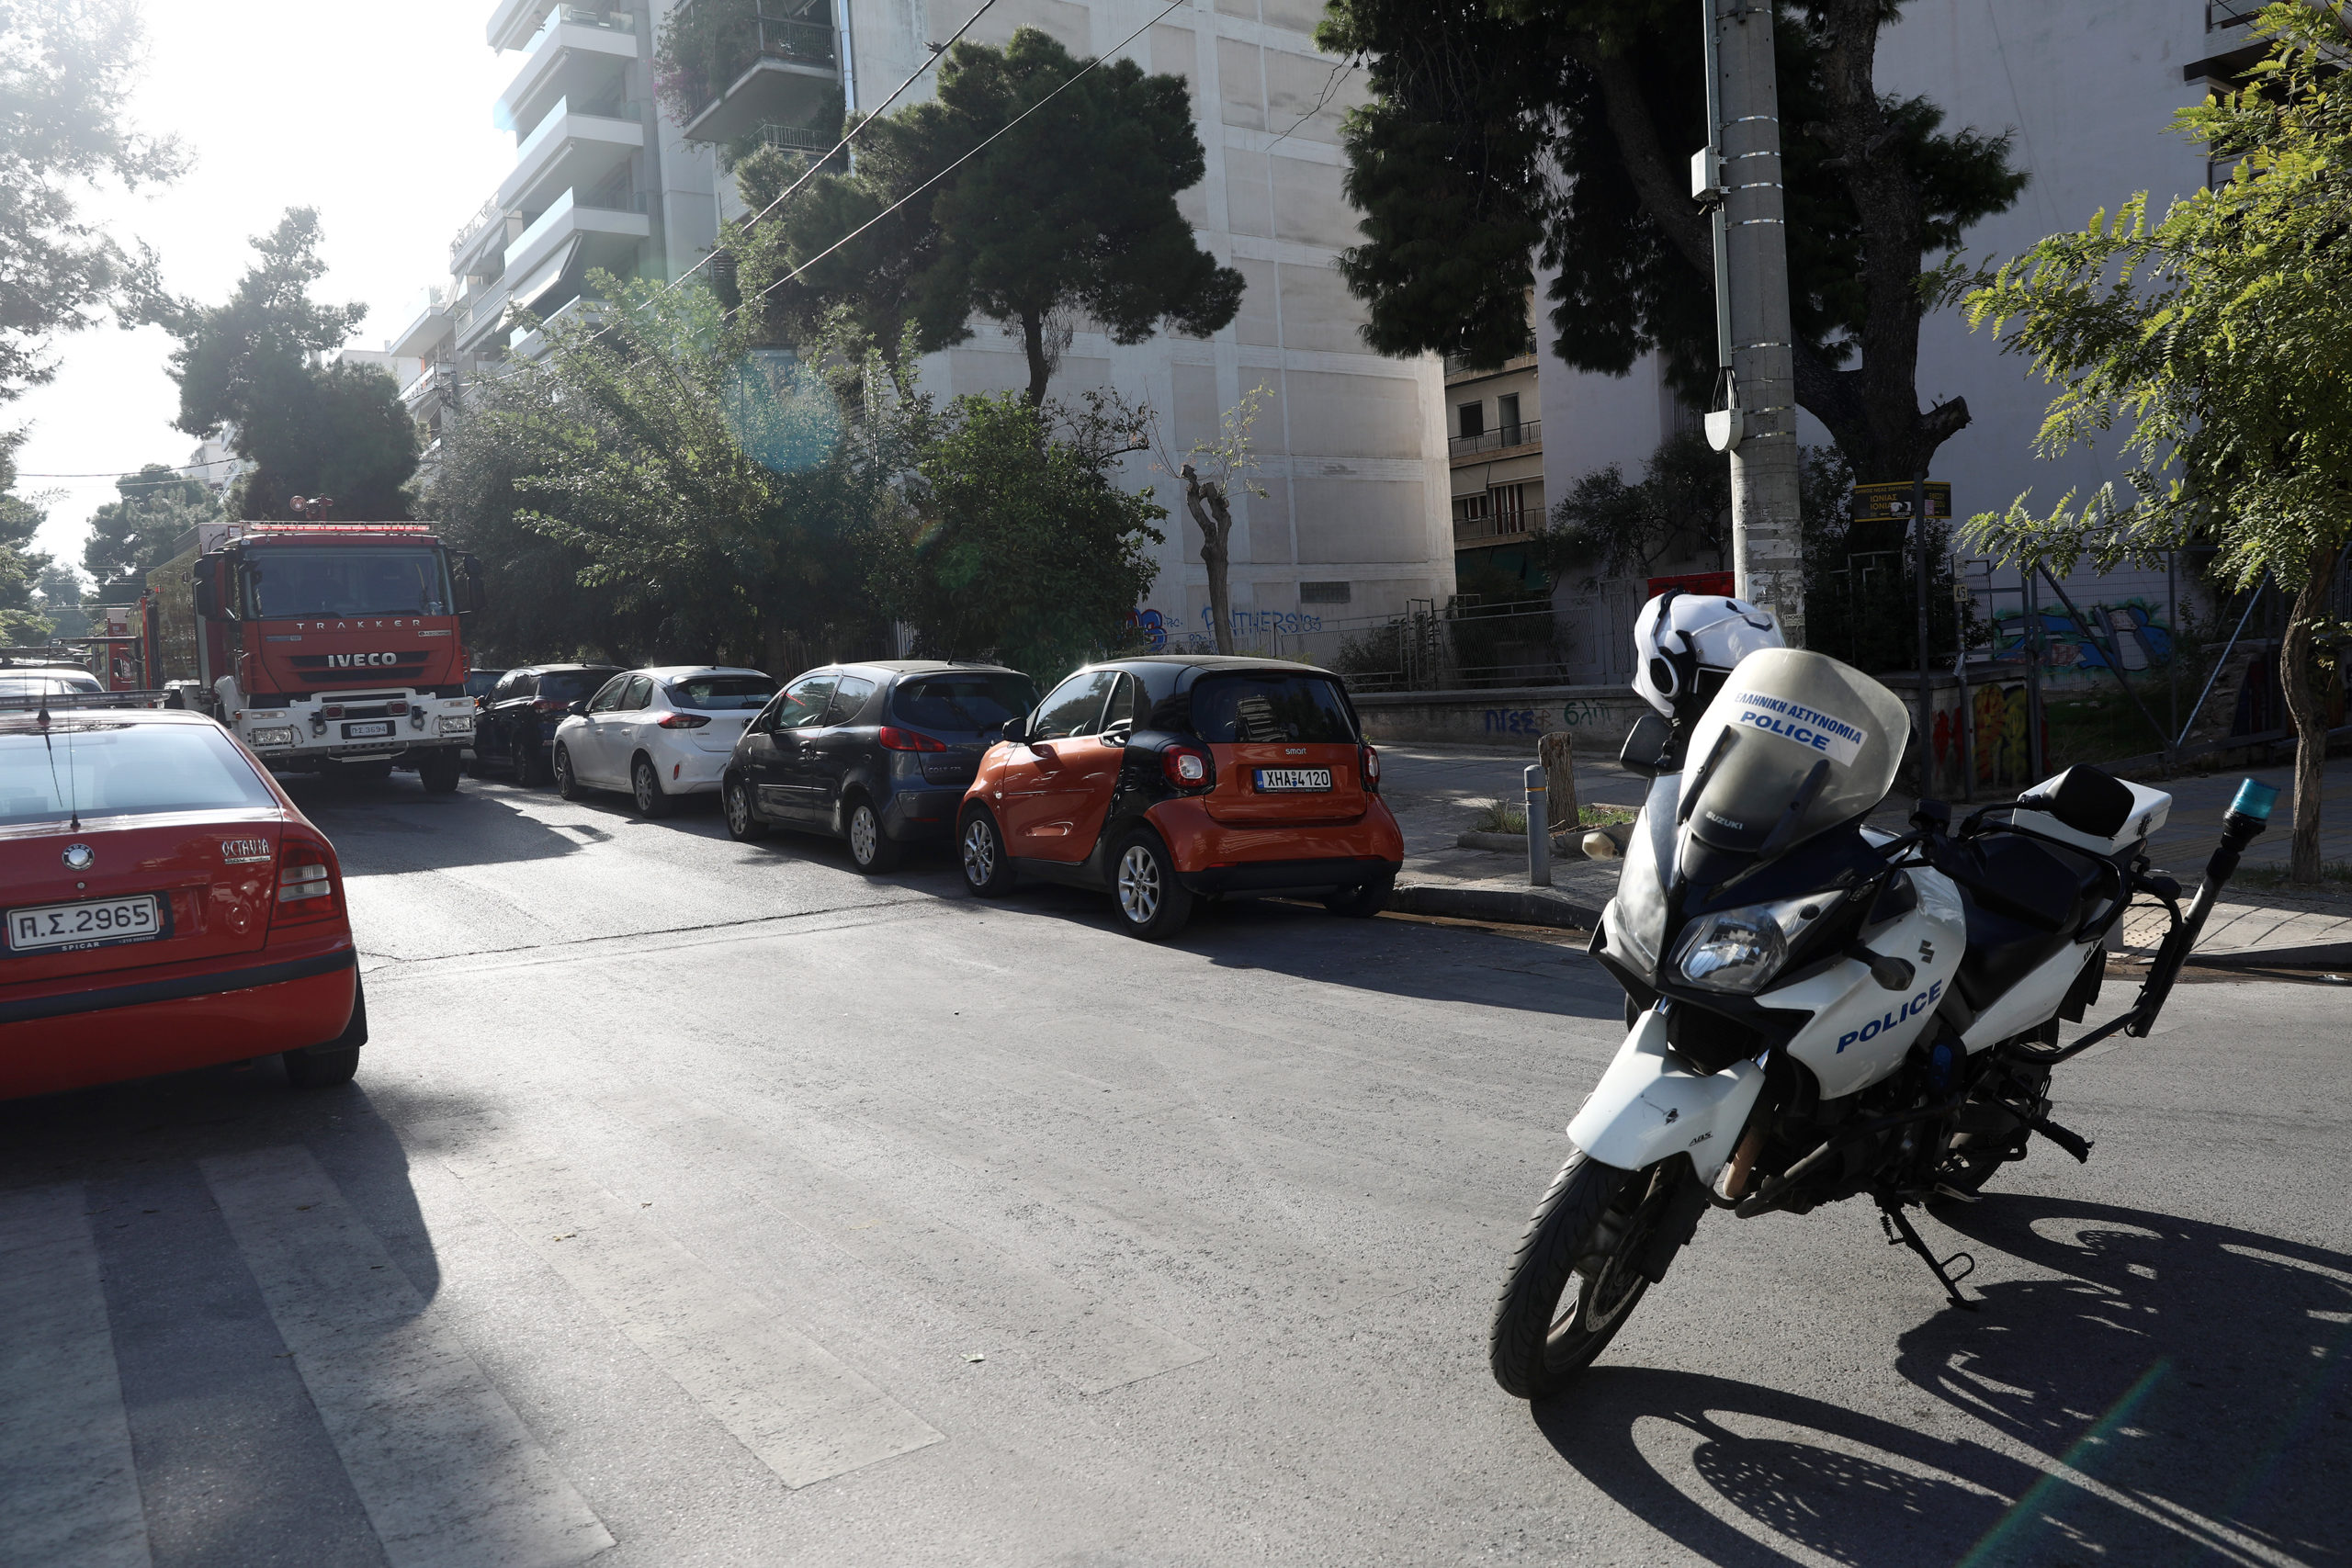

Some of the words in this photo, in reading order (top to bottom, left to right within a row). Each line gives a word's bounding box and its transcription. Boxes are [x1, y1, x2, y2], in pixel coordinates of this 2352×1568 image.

[296, 619, 421, 630] TRAKKER
[1201, 606, 1298, 637] PNTHERS
[328, 652, 397, 668] IVECO
[1735, 692, 1788, 714] ΕΛΛΗΝΙΚΗ
[1787, 705, 1864, 745] ΑΣΤΥΝΟΜΙΑ
[1740, 711, 1830, 751] POLICE
[1285, 747, 1306, 755] smart
[1705, 810, 1743, 830] SUZUKI
[221, 838, 269, 857] OCTAVIA
[19, 903, 151, 939] Π.Σ.2965
[62, 941, 100, 952] SPICAR
[1835, 978, 1944, 1055] POLICE
